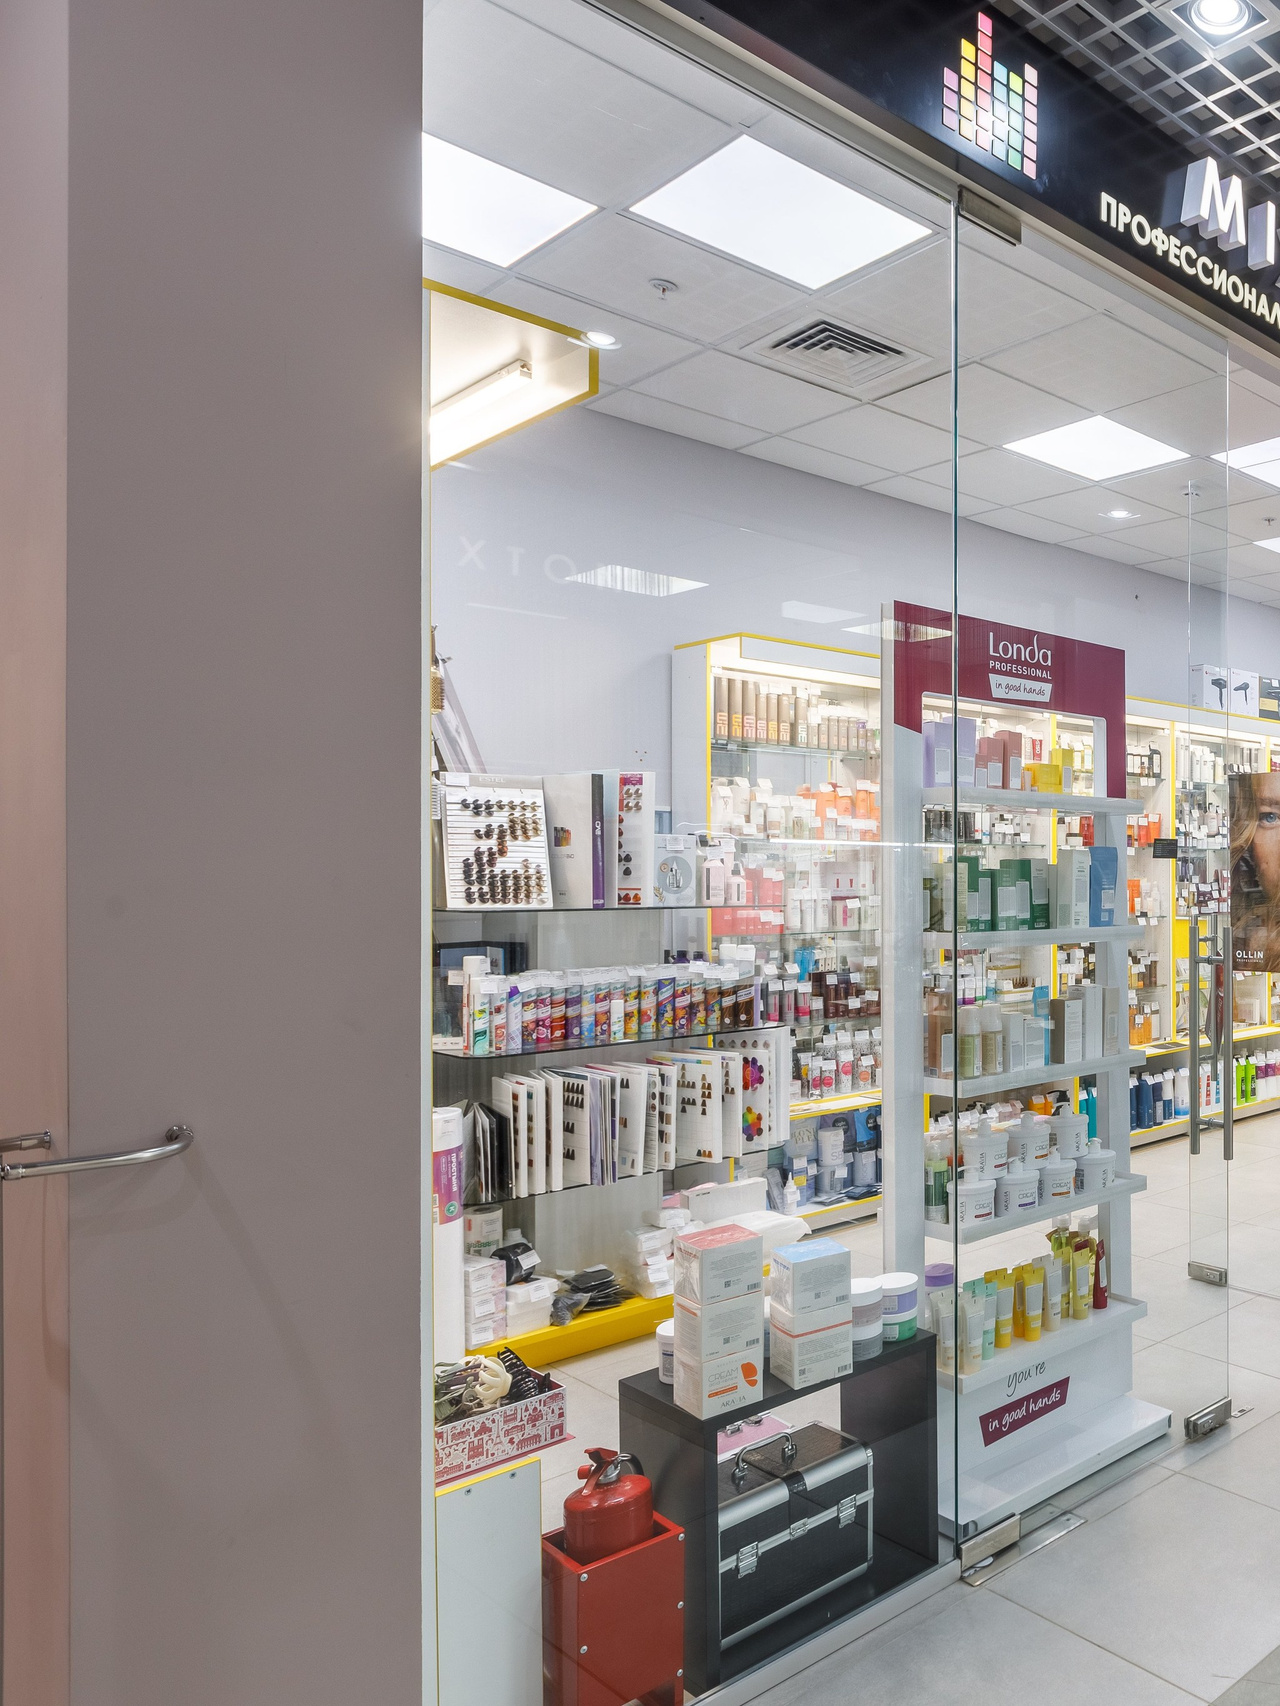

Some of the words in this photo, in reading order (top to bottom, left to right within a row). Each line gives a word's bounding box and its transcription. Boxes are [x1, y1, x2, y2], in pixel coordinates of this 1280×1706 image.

[988, 631, 1053, 666] Londa
[988, 660, 1053, 680] PROFESSIONAL
[995, 679, 1003, 690] in
[1003, 682, 1022, 696] good
[1022, 684, 1047, 697] hands
[1235, 950, 1264, 959] OLLIN
[707, 1366, 739, 1383] CREAM
[1006, 1360, 1046, 1398] you're
[988, 1417, 1000, 1432] in
[1001, 1401, 1027, 1432] good
[1029, 1386, 1062, 1412] hands
